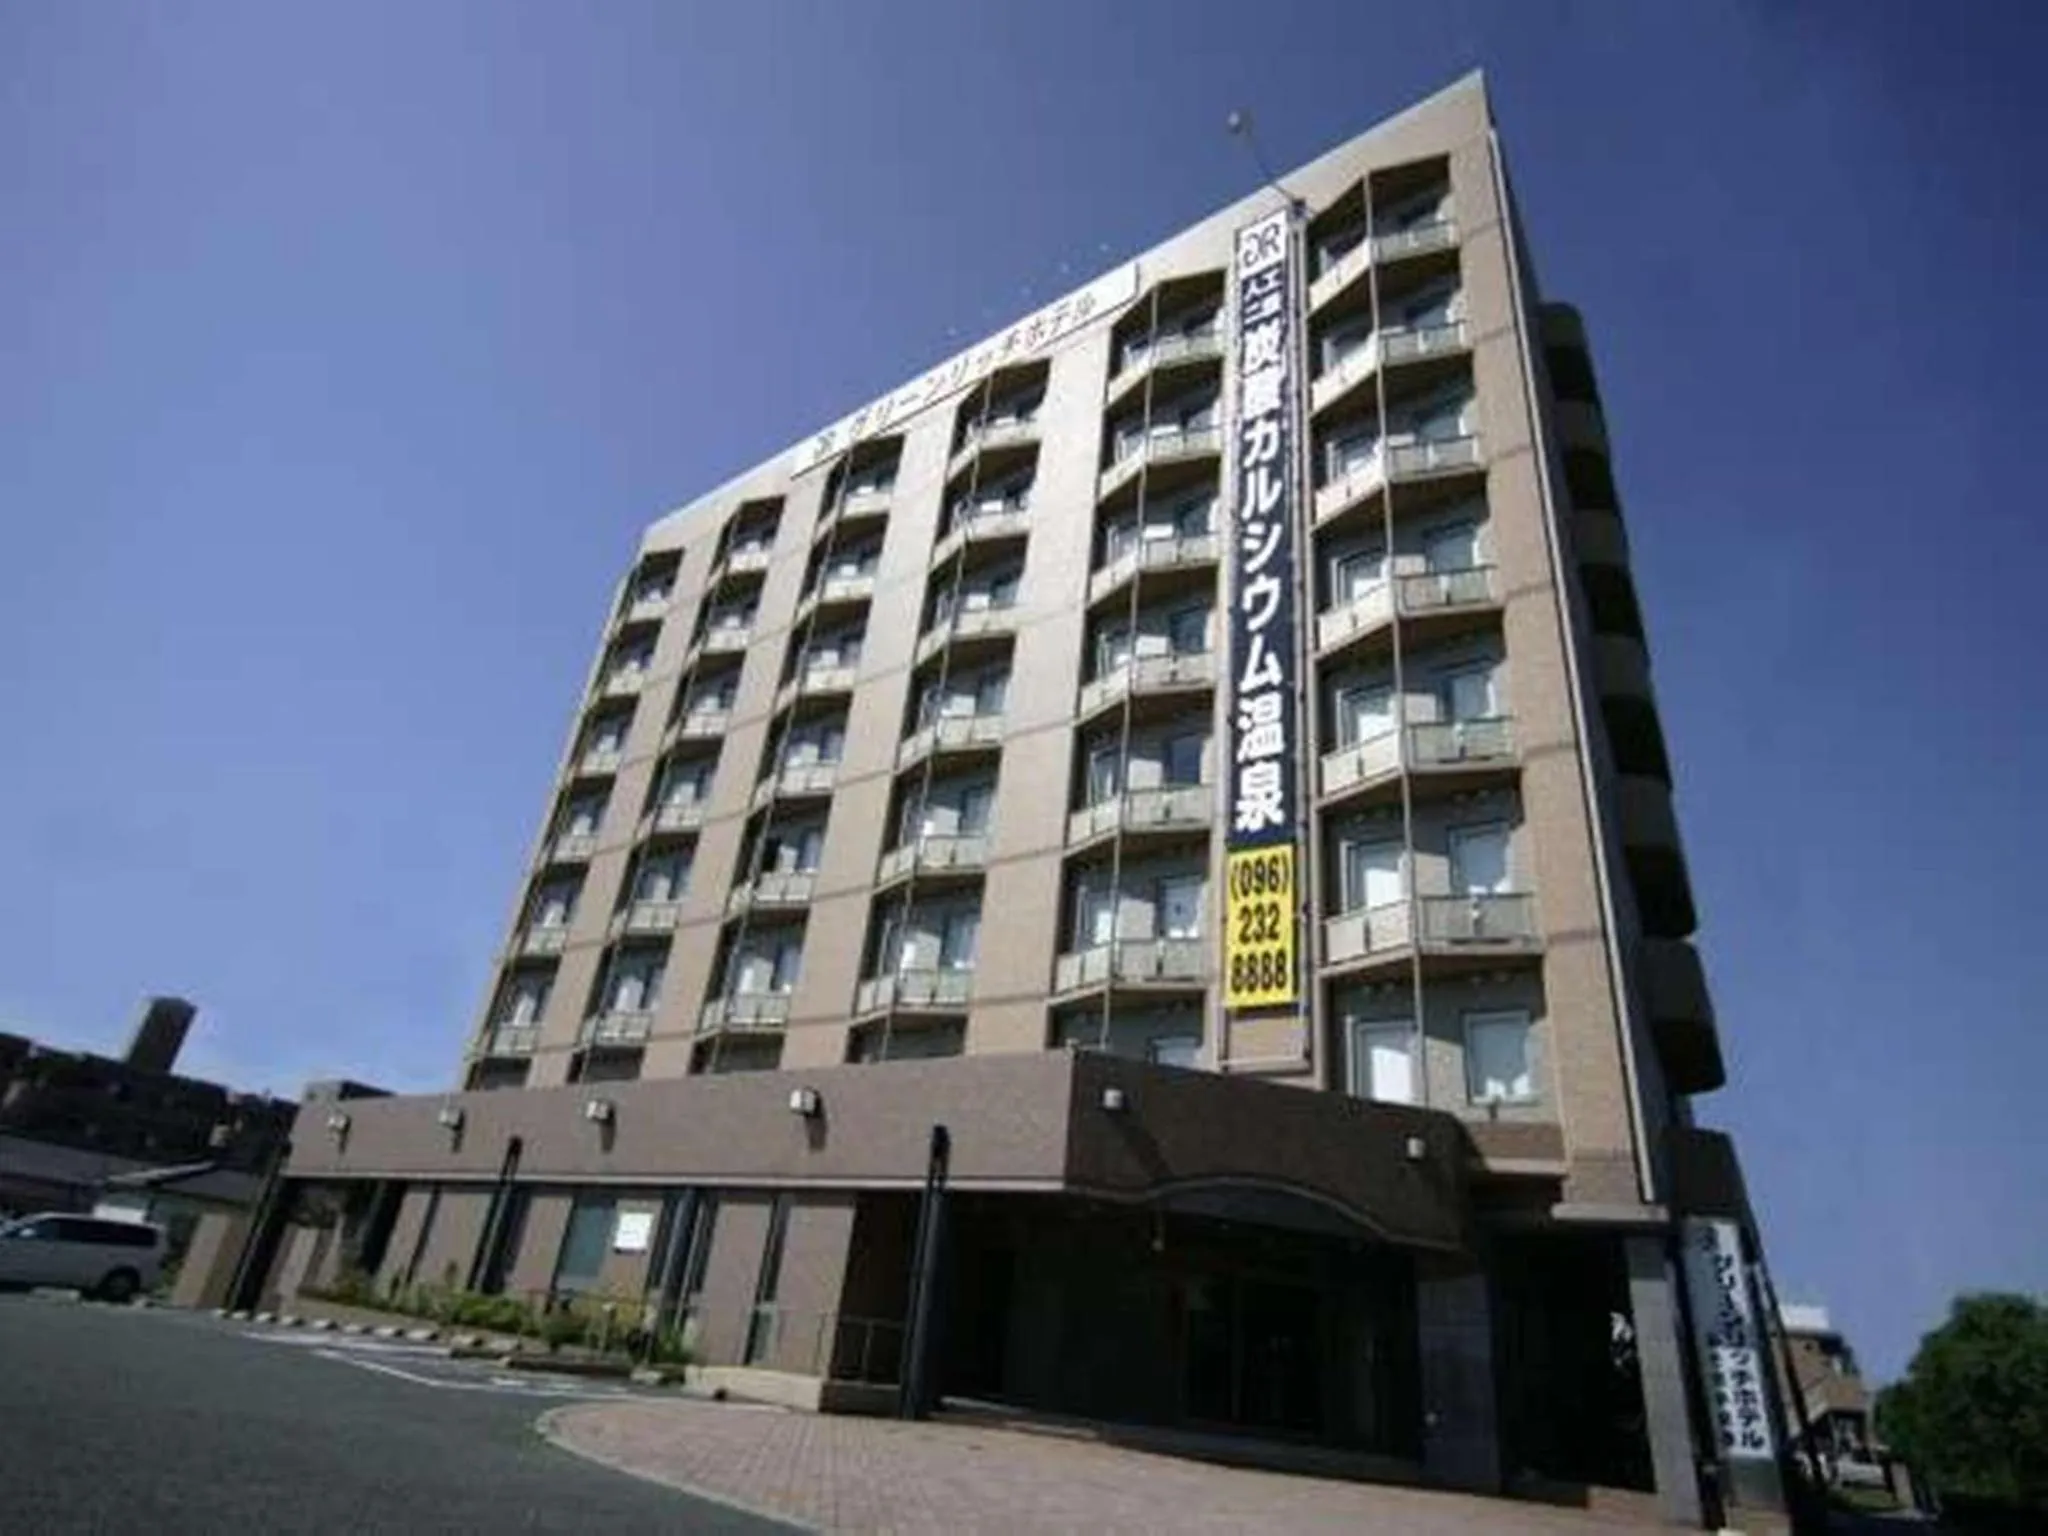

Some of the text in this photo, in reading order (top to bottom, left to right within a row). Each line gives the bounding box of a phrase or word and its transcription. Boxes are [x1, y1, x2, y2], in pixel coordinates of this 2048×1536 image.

[1230, 853, 1290, 901] (096)
[1237, 903, 1281, 944] 232
[1230, 949, 1287, 994] 8888
